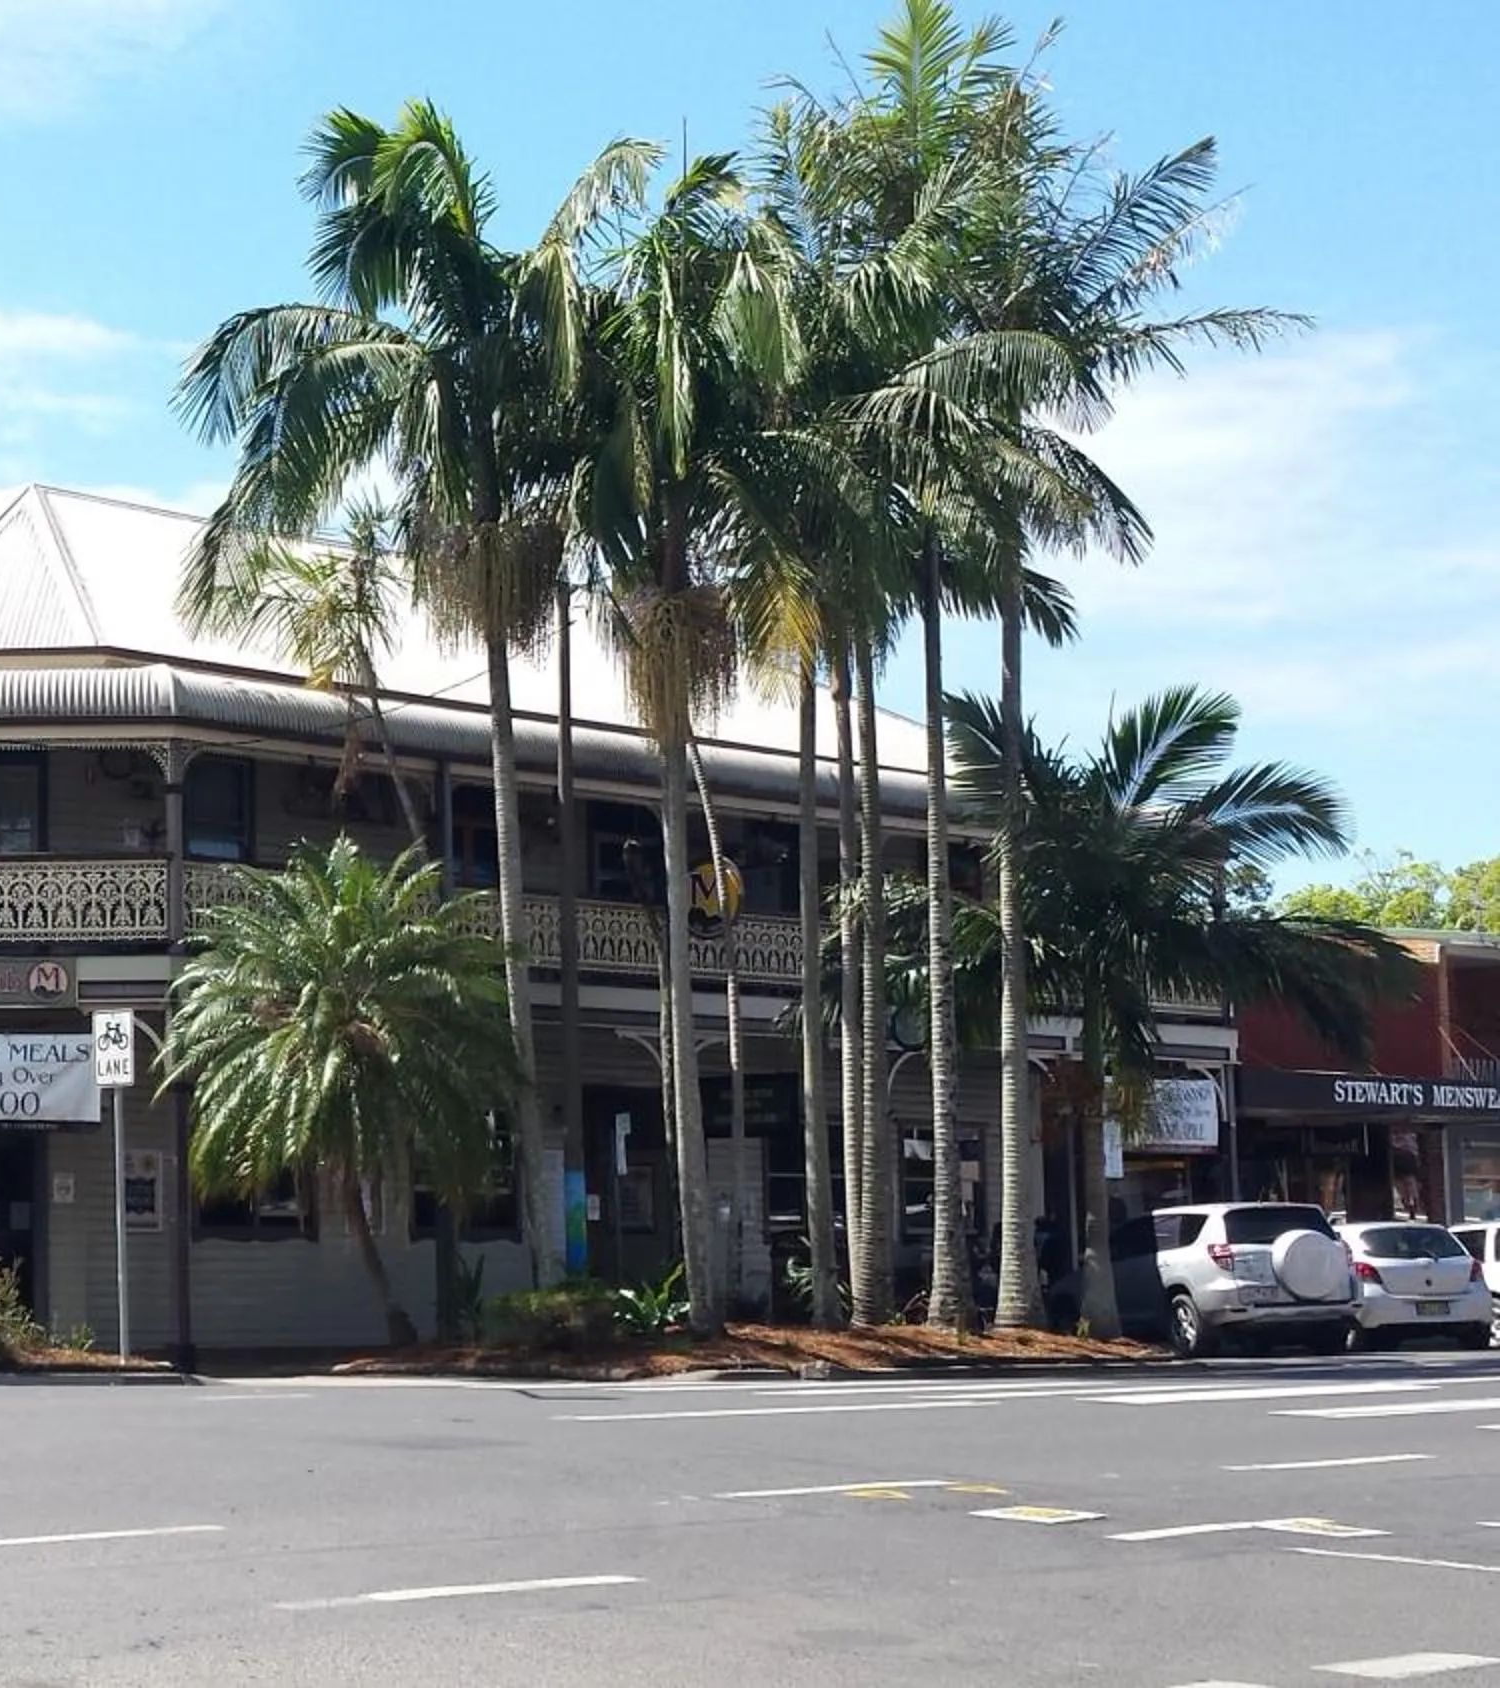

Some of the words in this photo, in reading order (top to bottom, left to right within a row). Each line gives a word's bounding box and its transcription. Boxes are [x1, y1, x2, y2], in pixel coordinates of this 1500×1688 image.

[12, 1066, 56, 1085] Over
[97, 1058, 130, 1078] LANE
[1334, 1079, 1423, 1106] STEWART'S
